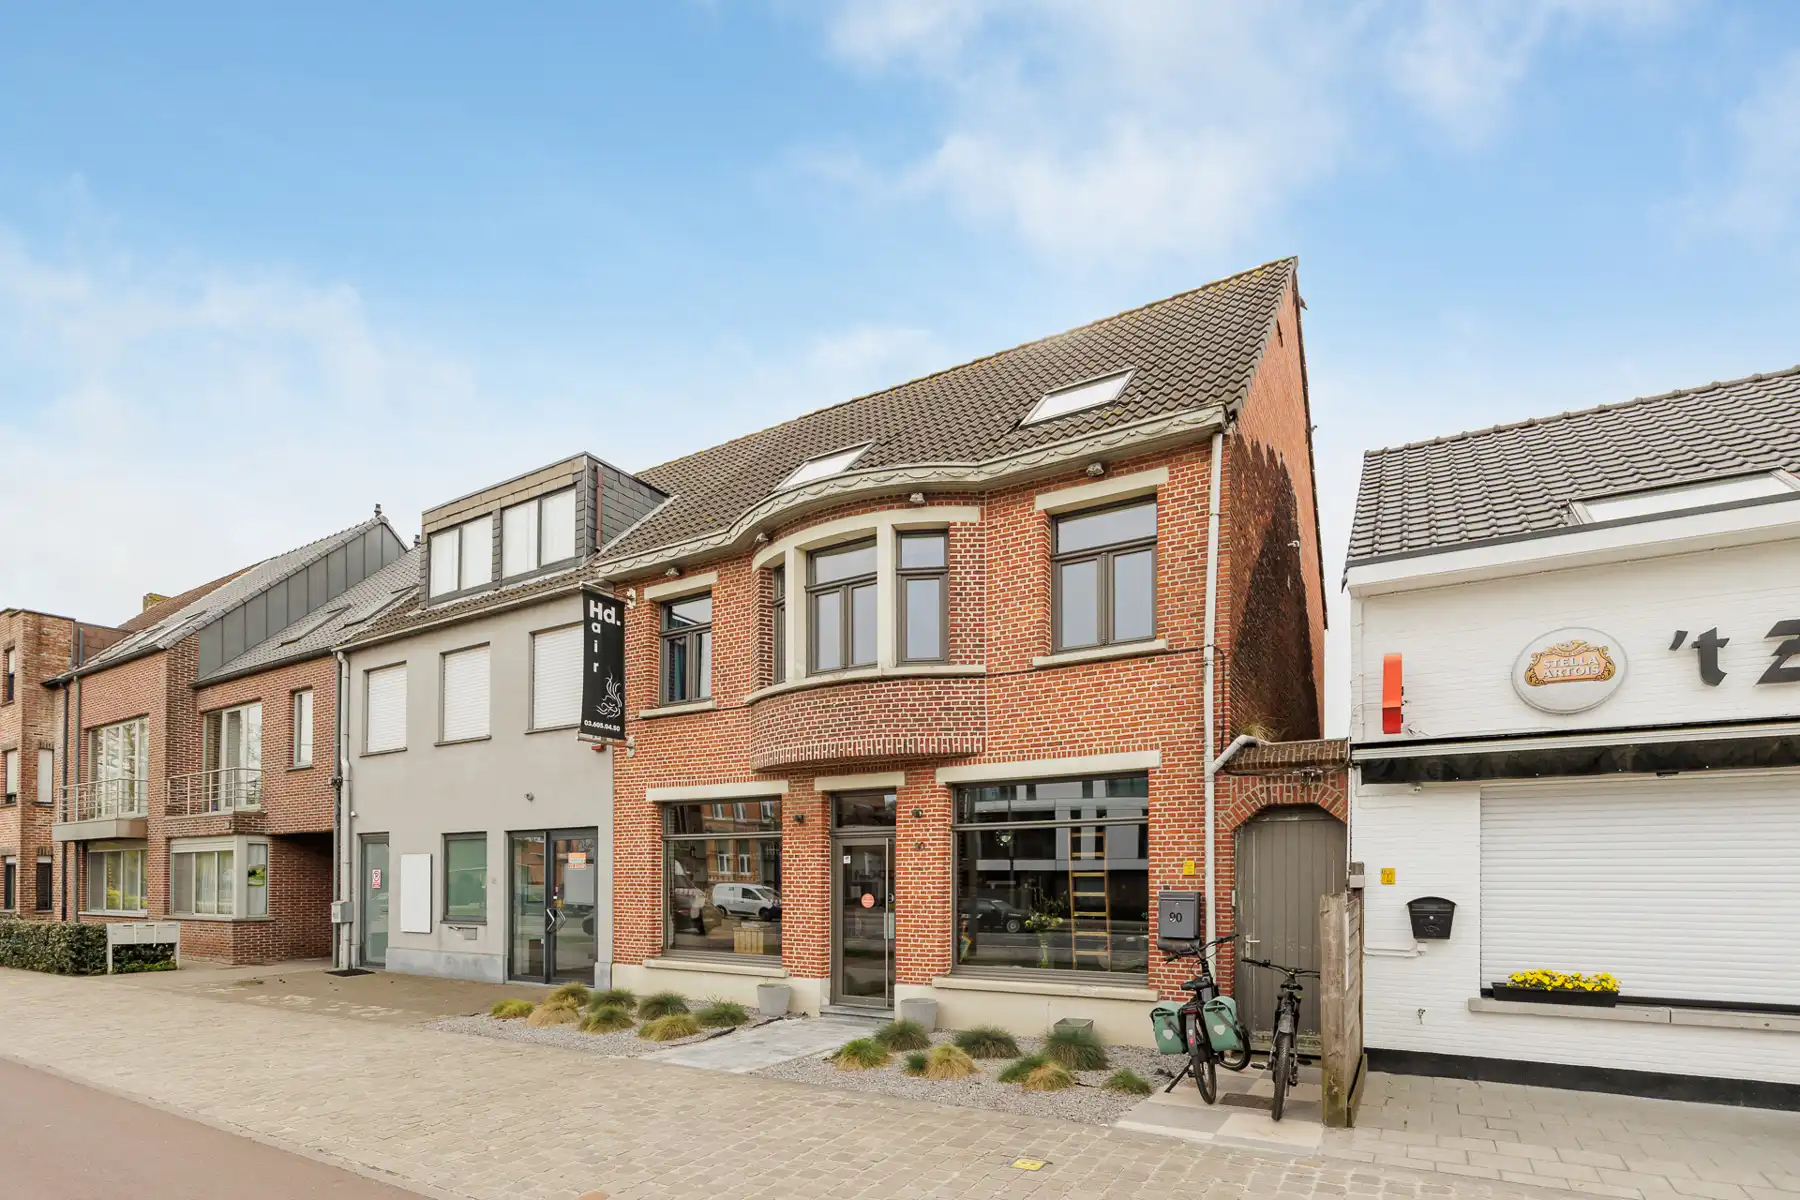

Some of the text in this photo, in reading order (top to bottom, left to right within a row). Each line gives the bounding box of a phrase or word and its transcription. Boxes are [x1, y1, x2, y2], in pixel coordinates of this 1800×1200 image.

[589, 599, 621, 626] Hd.
[1543, 655, 1600, 670] STELLA
[1543, 665, 1601, 679] ARTOIS
[1169, 912, 1183, 923] 90
